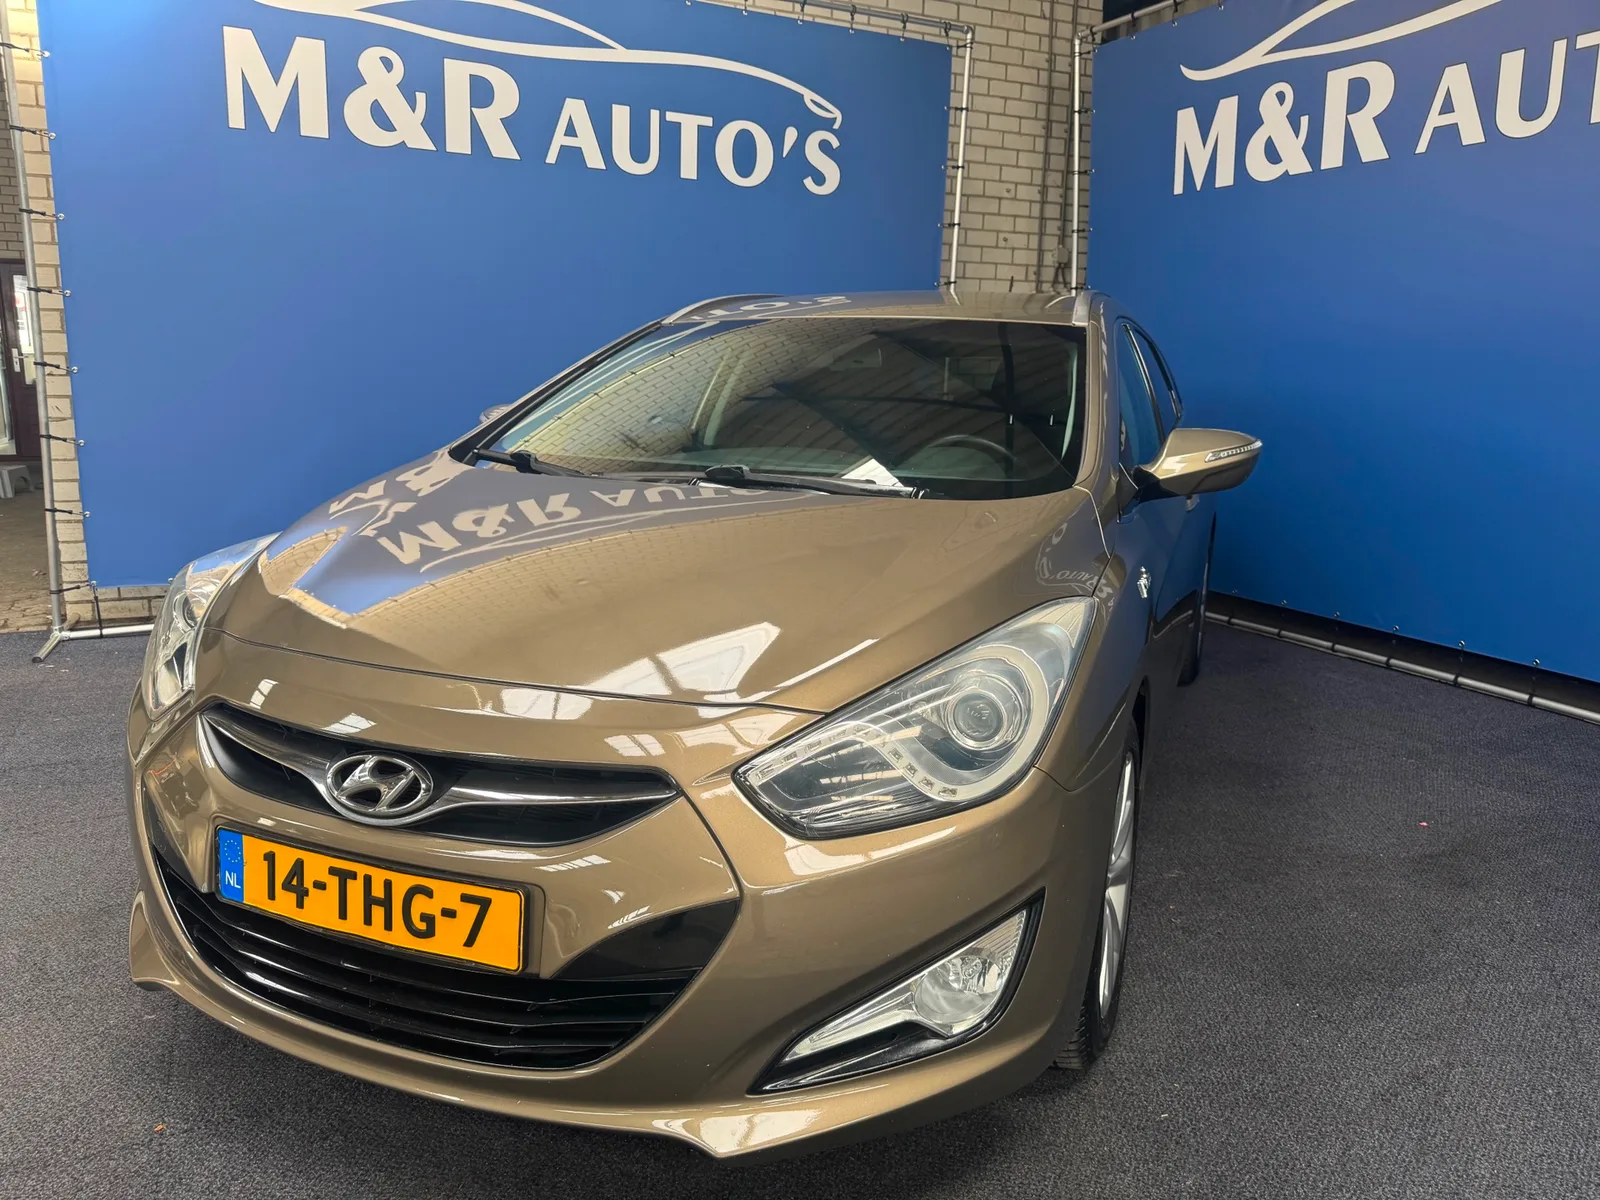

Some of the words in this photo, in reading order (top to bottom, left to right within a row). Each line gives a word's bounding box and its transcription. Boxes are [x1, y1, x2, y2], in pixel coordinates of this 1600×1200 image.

[222, 26, 521, 161] M&R
[545, 97, 842, 196] AUTO'S
[1173, 60, 1396, 196] M&R
[225, 870, 241, 889] NL
[263, 851, 492, 948] 14-THG-7
